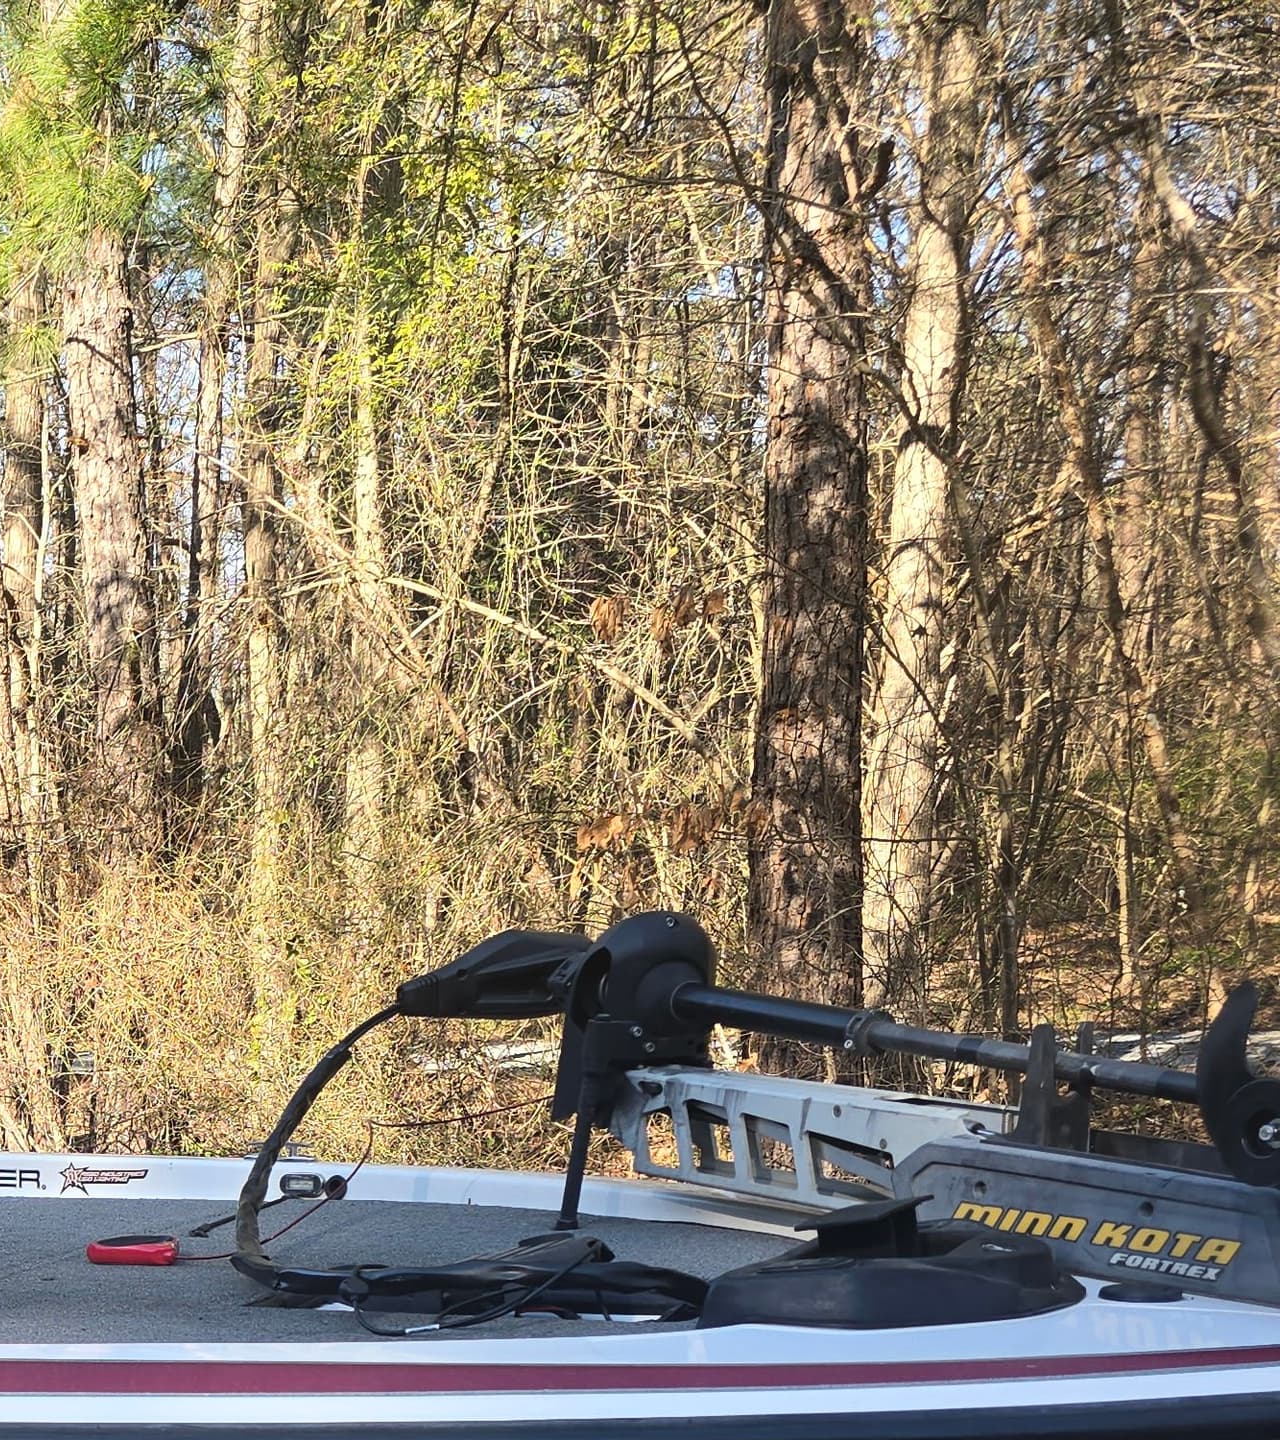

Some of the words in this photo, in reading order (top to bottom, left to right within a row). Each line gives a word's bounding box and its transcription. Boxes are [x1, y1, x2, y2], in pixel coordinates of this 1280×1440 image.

[952, 1200, 1088, 1242] MINN
[1091, 1220, 1242, 1266] KOTA
[1109, 1251, 1226, 1282] FORTREX
